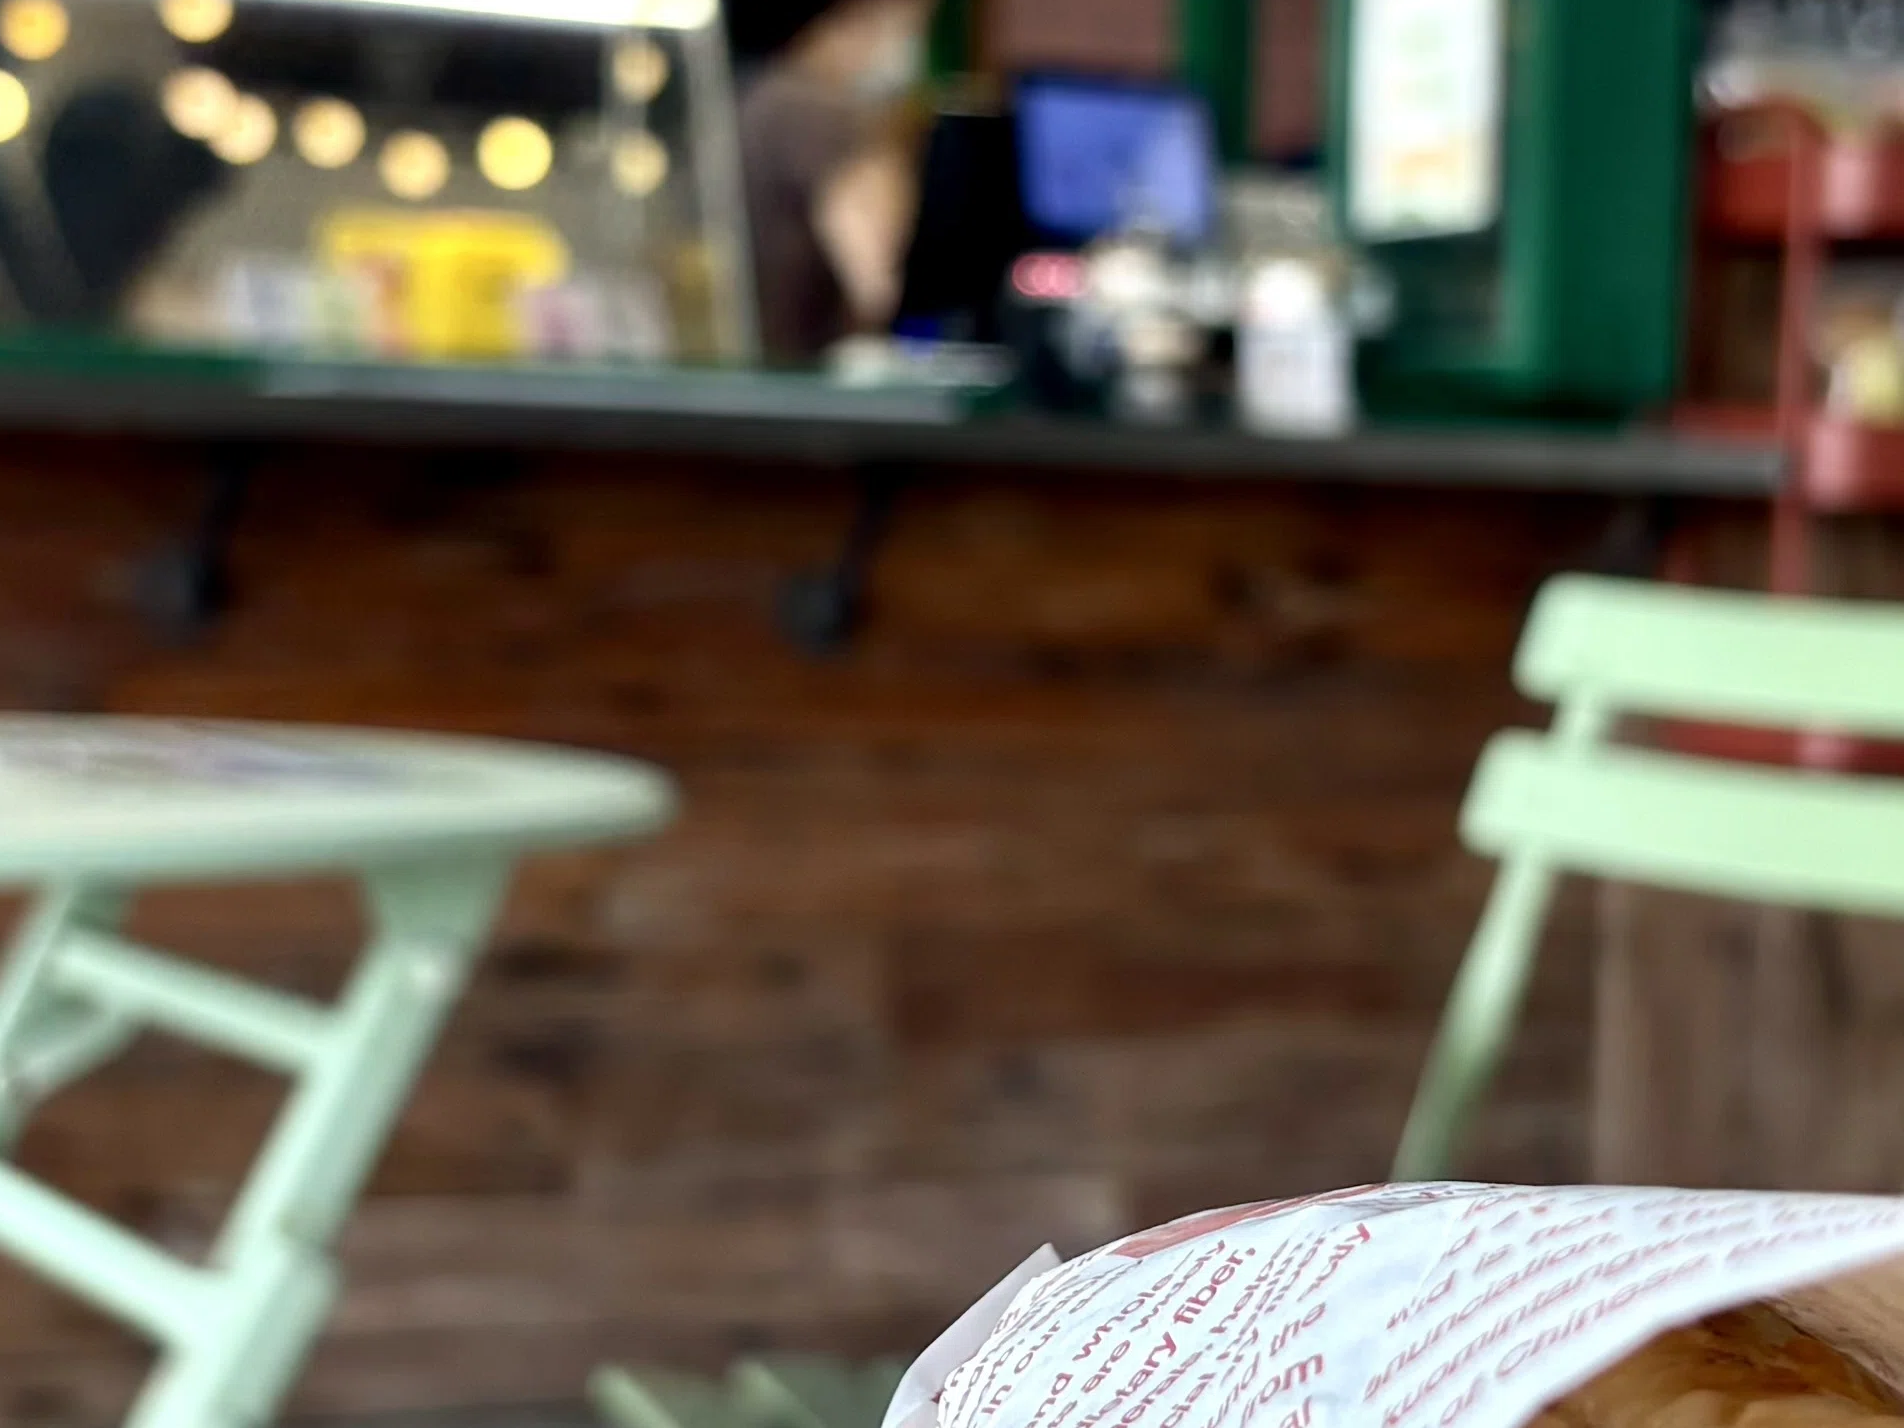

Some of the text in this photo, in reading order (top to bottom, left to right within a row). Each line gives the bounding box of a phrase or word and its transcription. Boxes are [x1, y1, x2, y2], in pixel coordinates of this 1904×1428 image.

[1172, 1247, 1256, 1325] fiber,
[1268, 1301, 1328, 1359] the
[1080, 1339, 1132, 1395] are
